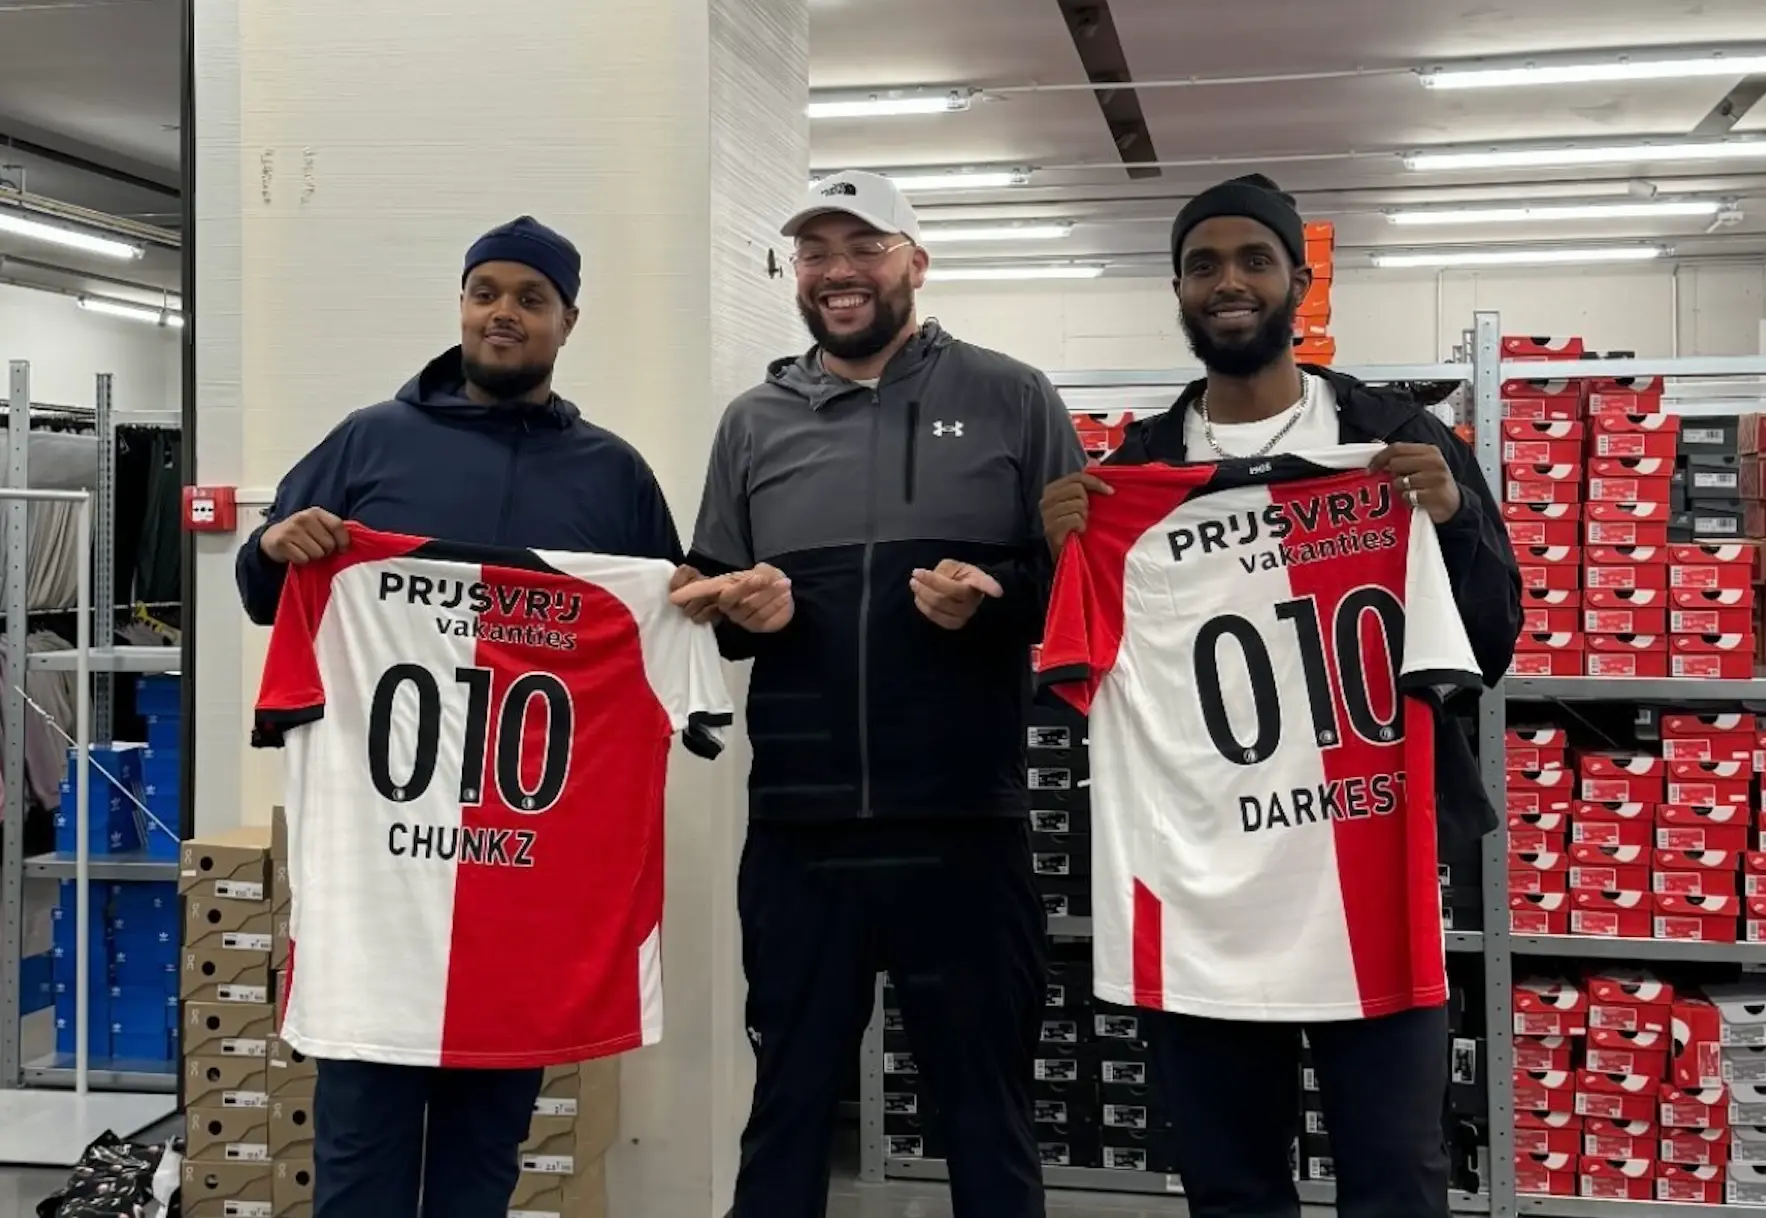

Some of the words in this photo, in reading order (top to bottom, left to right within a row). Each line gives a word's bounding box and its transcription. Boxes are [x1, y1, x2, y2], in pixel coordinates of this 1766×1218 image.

[1239, 526, 1397, 574] vakanties
[436, 615, 577, 651] vakanties
[1193, 584, 1406, 766] 010
[368, 662, 575, 814] 010
[388, 823, 536, 868] CHUNKZ
